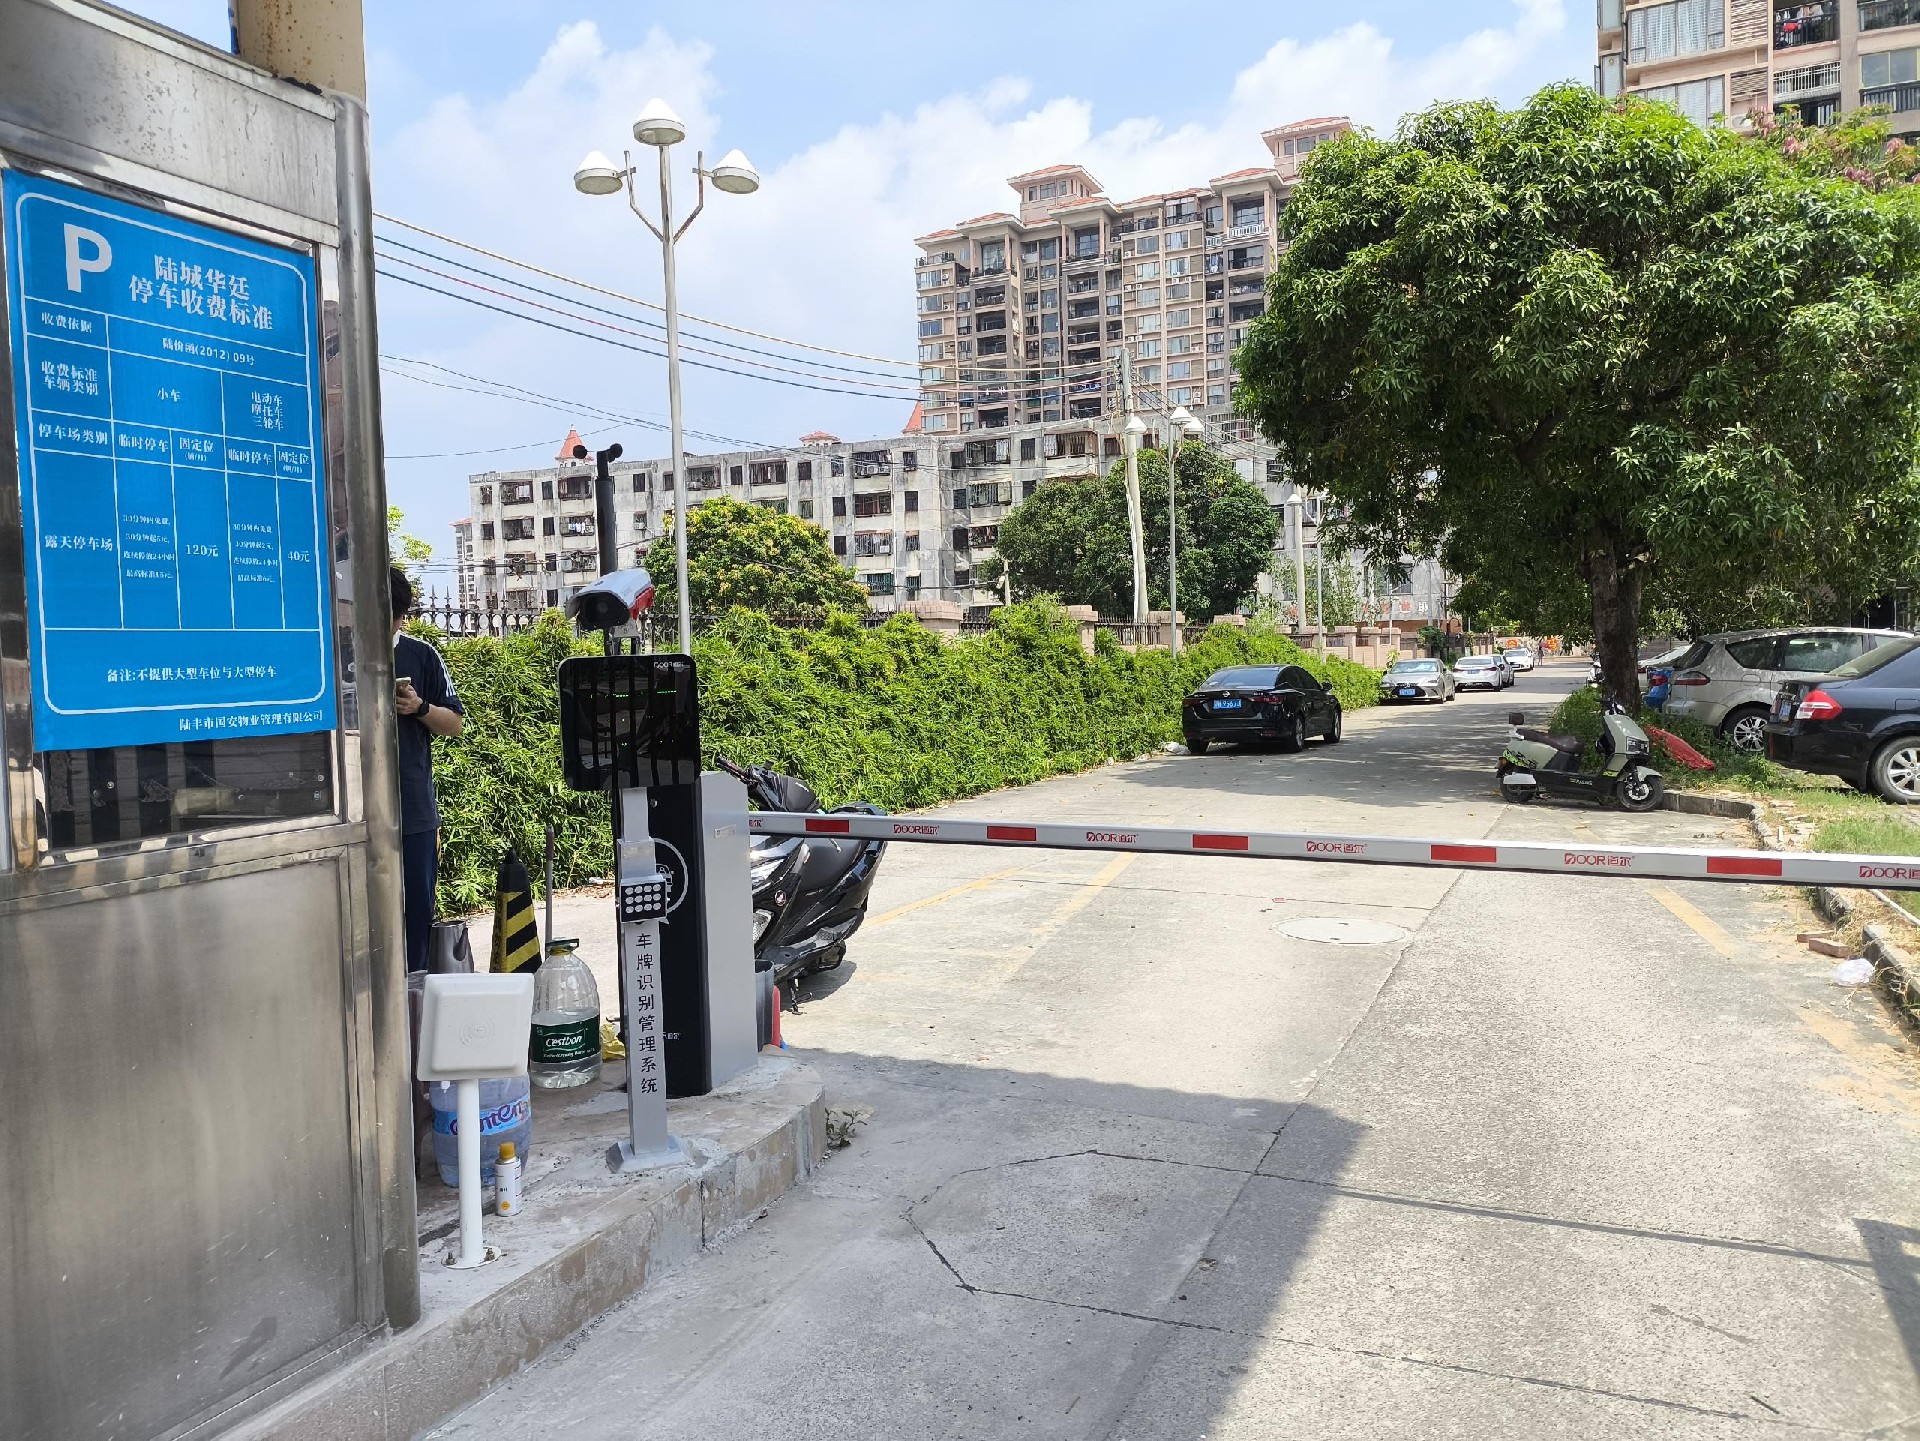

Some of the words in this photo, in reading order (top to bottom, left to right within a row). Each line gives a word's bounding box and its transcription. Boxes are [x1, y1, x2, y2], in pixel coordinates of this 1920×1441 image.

[64, 223, 112, 292] P
[154, 254, 250, 299] 陆城华廷
[129, 275, 273, 330] 停车收费标准
[41, 311, 93, 334] 收费依据
[41, 360, 98, 382] 收费标准
[43, 374, 99, 396] 车辆类别
[157, 387, 181, 402] 小车
[251, 390, 283, 406] 电动车
[252, 415, 284, 431] 三轮车
[38, 422, 108, 445] 停车场类别
[118, 433, 169, 452] 临时停车
[179, 436, 214, 453] 固定位
[228, 448, 273, 466] 临时停车
[278, 450, 310, 465] 固定位
[44, 534, 113, 552] 露天停车场
[185, 544, 219, 558] 120元
[287, 550, 310, 563] 40元
[636, 933, 657, 1093] 车牌识别管理系统
